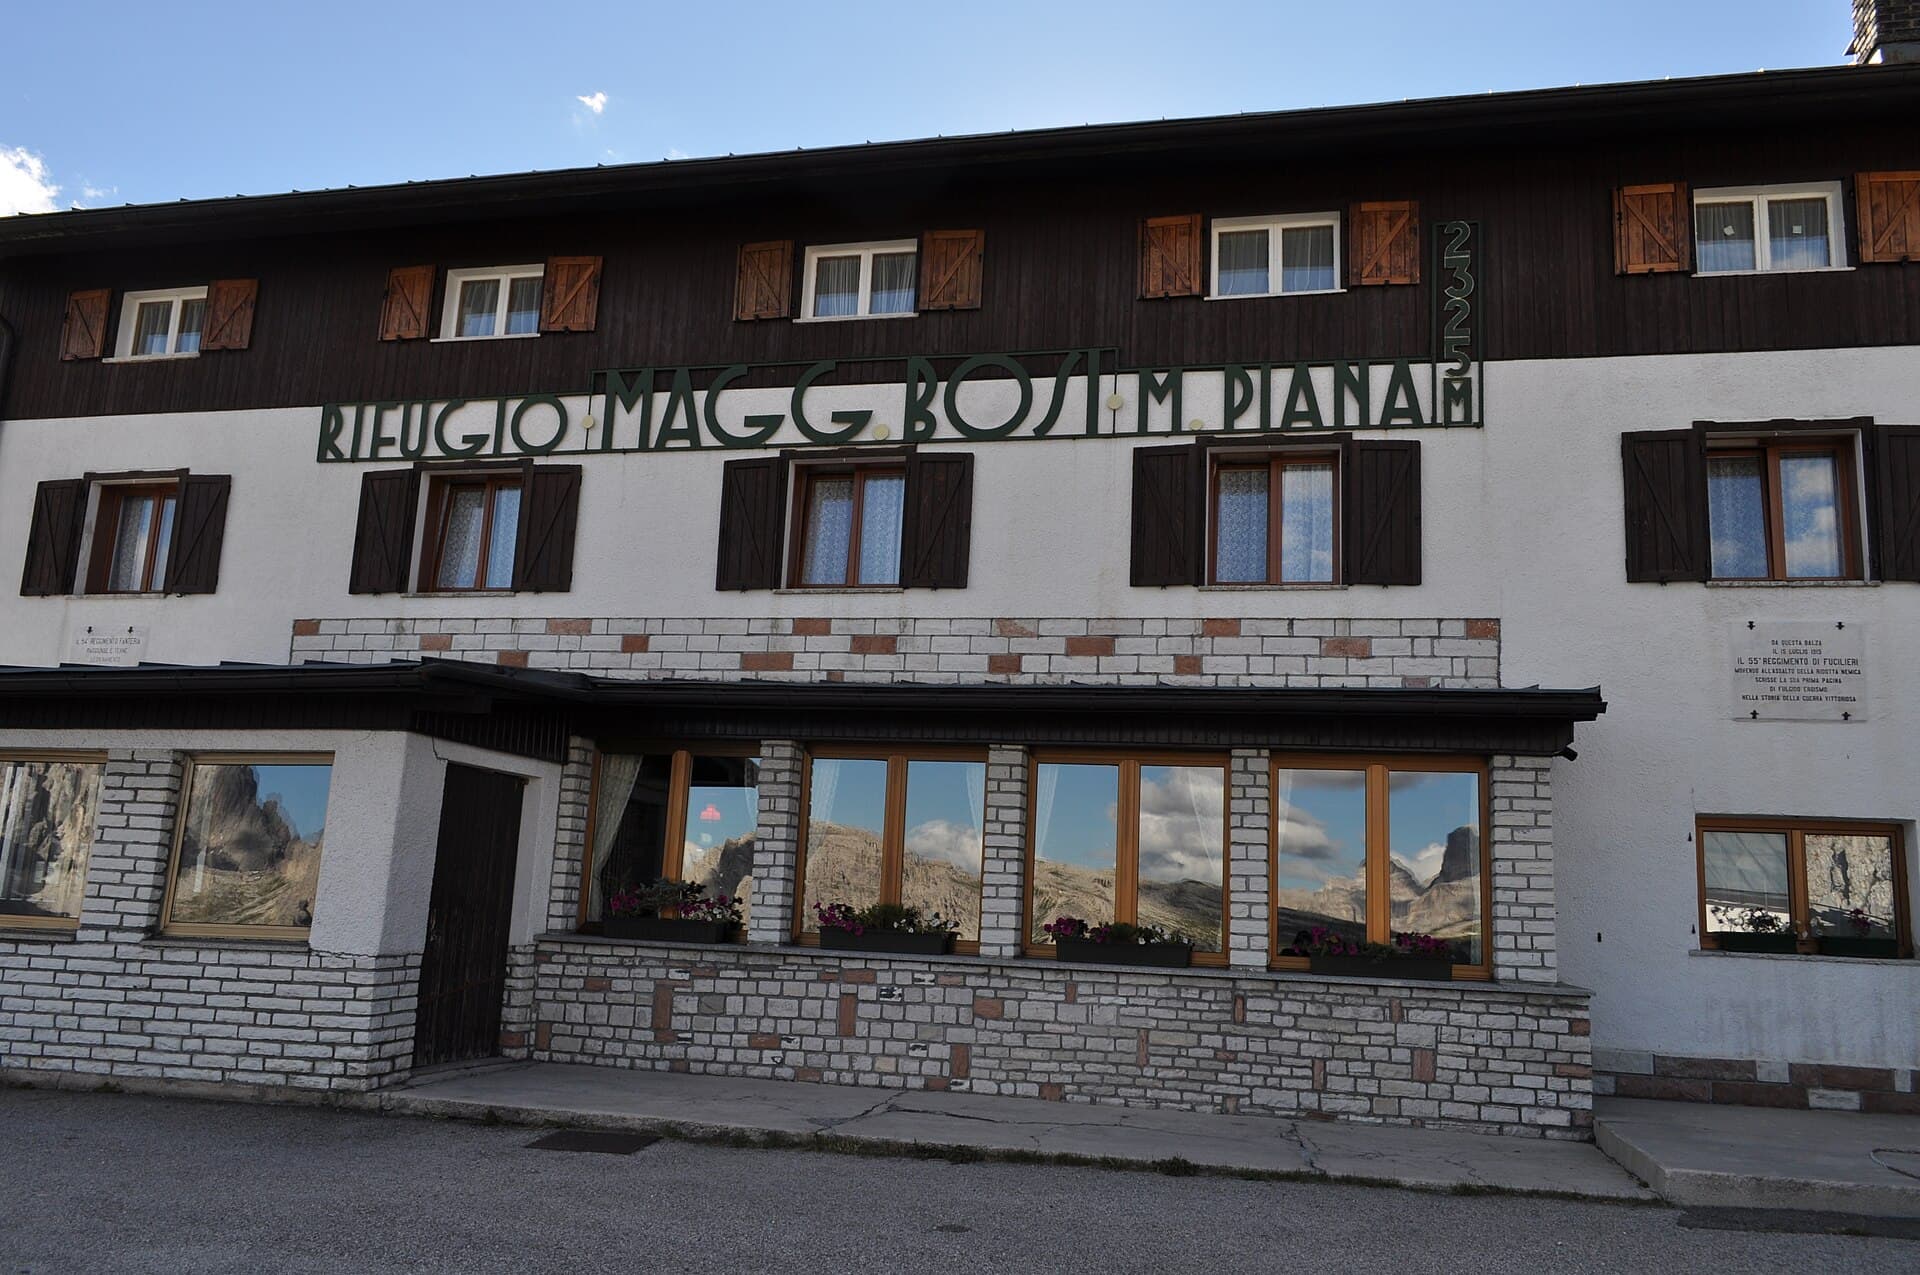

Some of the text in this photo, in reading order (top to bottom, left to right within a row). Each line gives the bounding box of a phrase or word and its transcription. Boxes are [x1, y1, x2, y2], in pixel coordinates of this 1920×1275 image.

[318, 393, 568, 461] RIFUGIO
[903, 350, 1100, 442] BOSI
[1224, 359, 1425, 433] PIANA
[1737, 657, 1745, 665] IL
[1762, 657, 1809, 665] REGGIMENTO
[1823, 658, 1859, 666] FUCILIERI
[1796, 667, 1814, 675] DELLA
